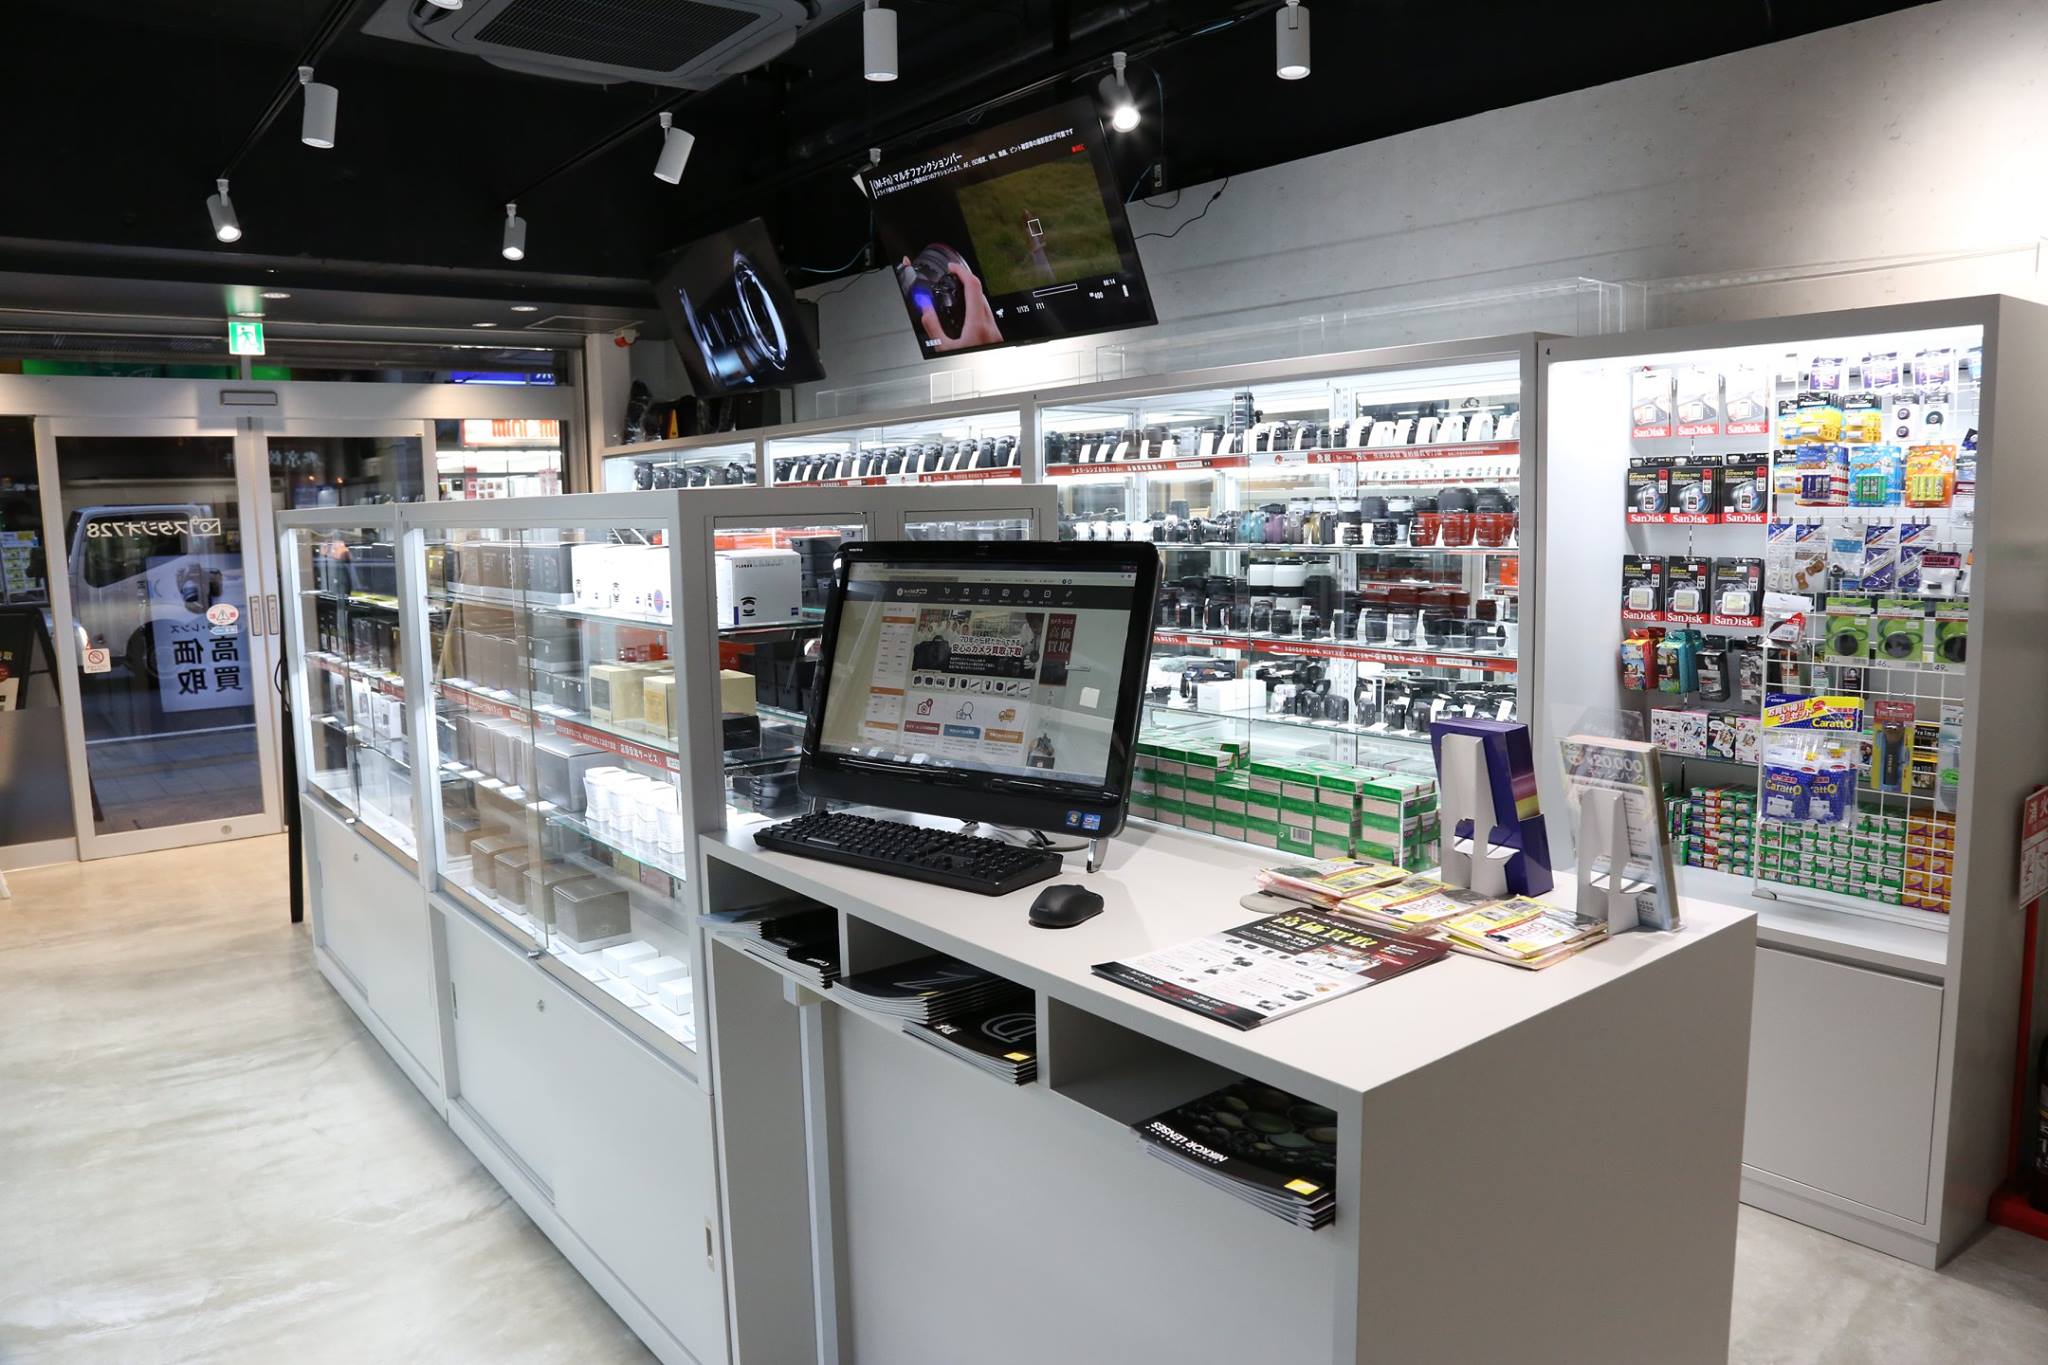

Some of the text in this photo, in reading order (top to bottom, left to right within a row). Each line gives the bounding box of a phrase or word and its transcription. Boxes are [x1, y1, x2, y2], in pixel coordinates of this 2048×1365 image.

[892, 152, 964, 186] マルチファンクションバー
[1633, 427, 1667, 438] SanDisk
[1677, 425, 1716, 436] SanDisk
[1727, 423, 1766, 434] SanDisk
[1631, 513, 1666, 523] SanDisk
[1673, 514, 1709, 524] SanDisk
[1726, 513, 1762, 523] SanDisk
[1623, 610, 1657, 621] SanDisk
[1667, 612, 1703, 624] SanDisk
[1714, 615, 1755, 627] SanDisk
[1151, 1121, 1188, 1144] LENSES
[1187, 1140, 1229, 1163] NIKKOR
